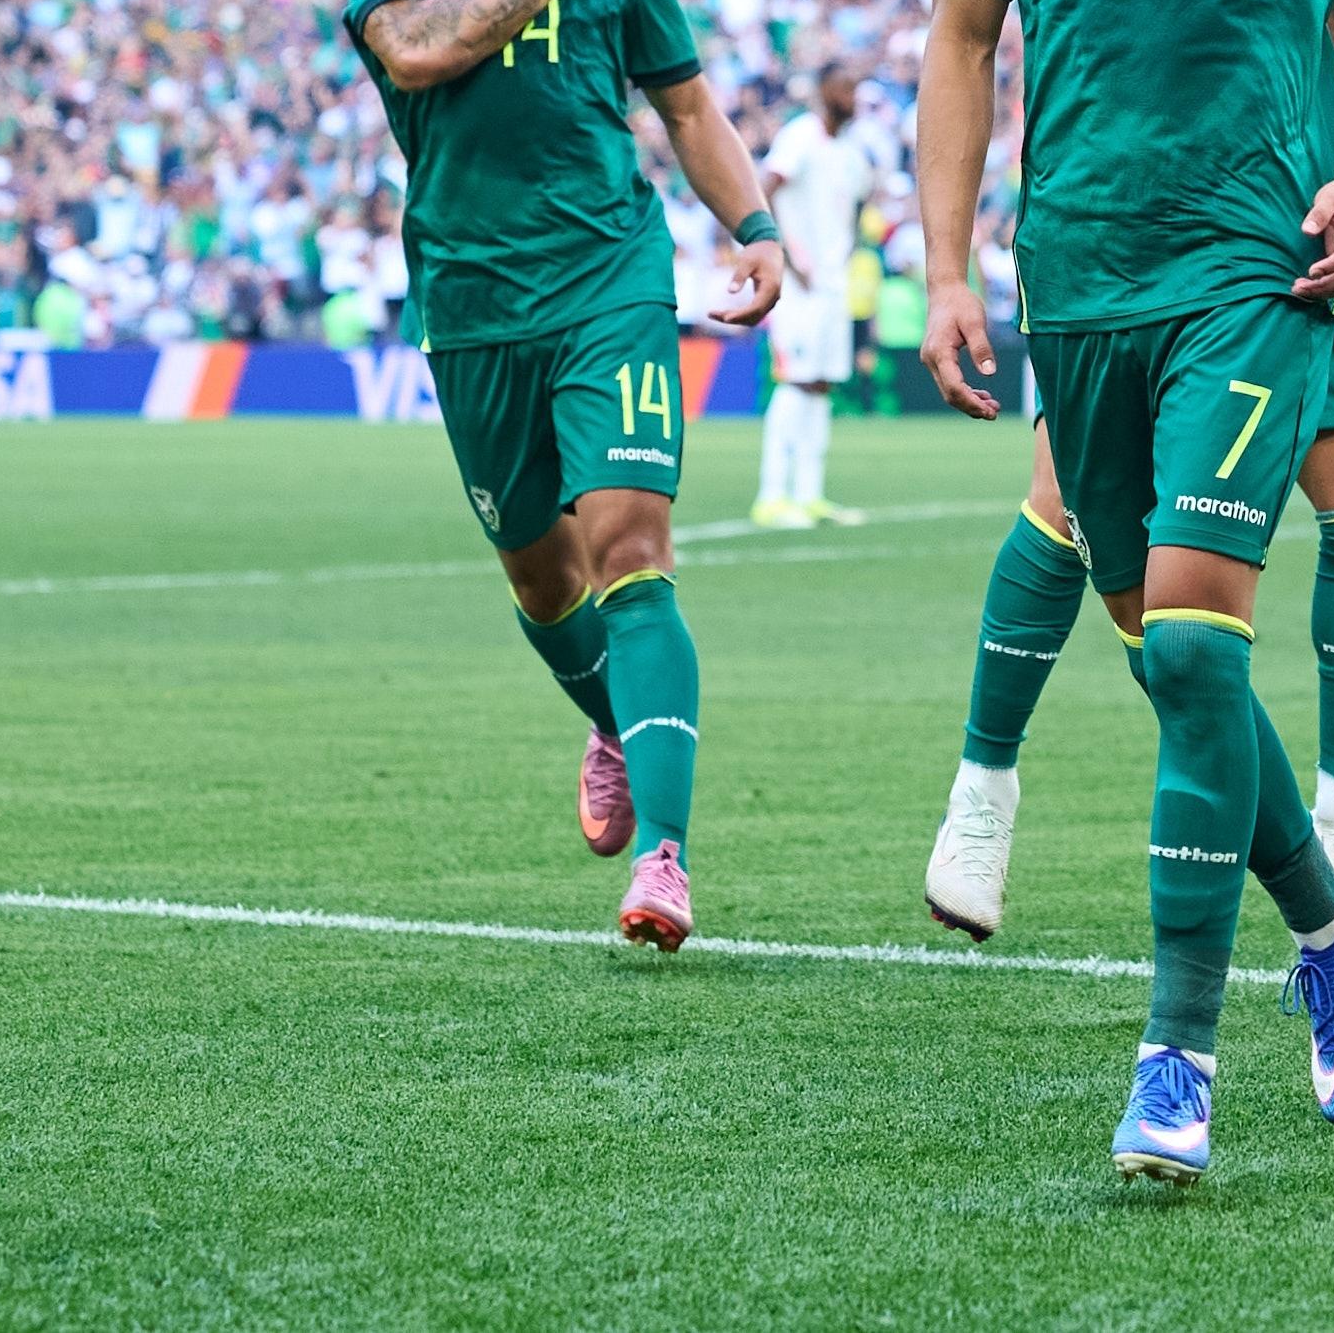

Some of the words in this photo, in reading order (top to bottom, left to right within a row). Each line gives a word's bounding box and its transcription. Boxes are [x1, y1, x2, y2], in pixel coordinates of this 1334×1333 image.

[615, 362, 672, 440] 14
[1215, 379, 1273, 480] 7
[608, 447, 676, 468] marathon
[1175, 494, 1267, 527] marathon
